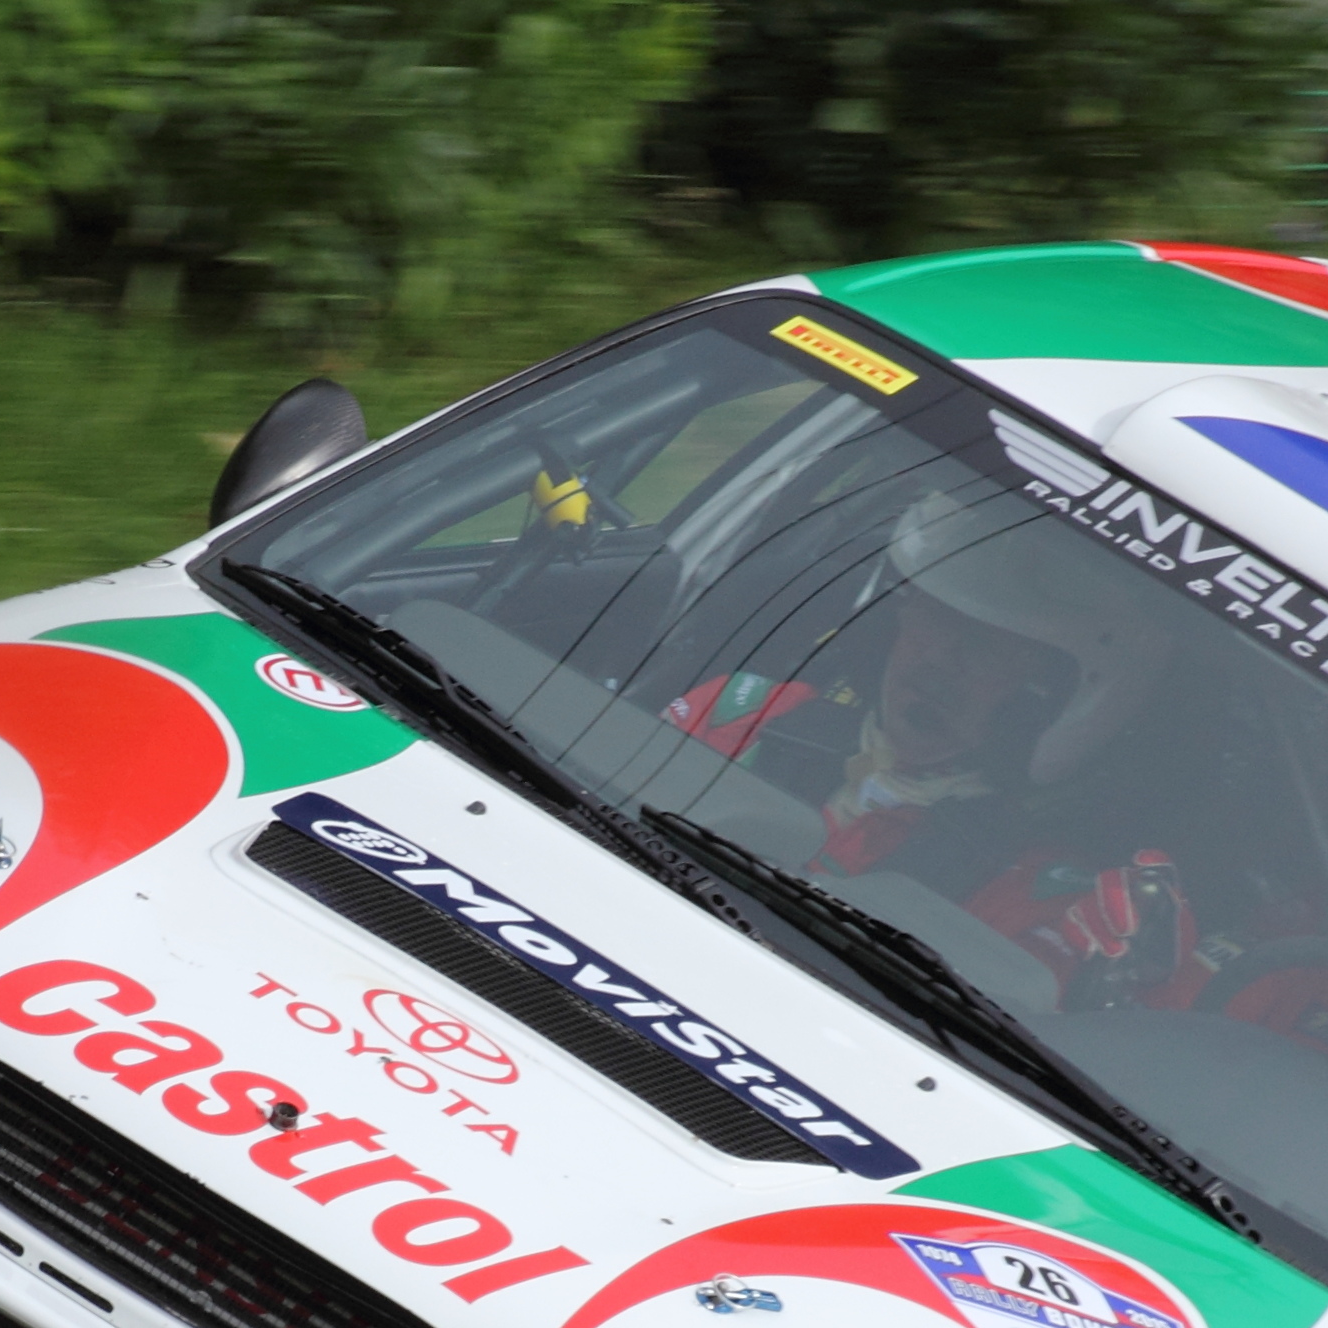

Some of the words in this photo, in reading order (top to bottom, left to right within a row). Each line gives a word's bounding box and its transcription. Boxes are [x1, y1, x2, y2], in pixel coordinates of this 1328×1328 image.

[1023, 479, 1176, 571] RALLIED
[1186, 579, 1213, 596] &
[248, 971, 521, 1157] TOYOTA
[394, 868, 874, 1150] MoviStar
[946, 1277, 1039, 1319] RALLY
[1003, 1255, 1080, 1306] 26
